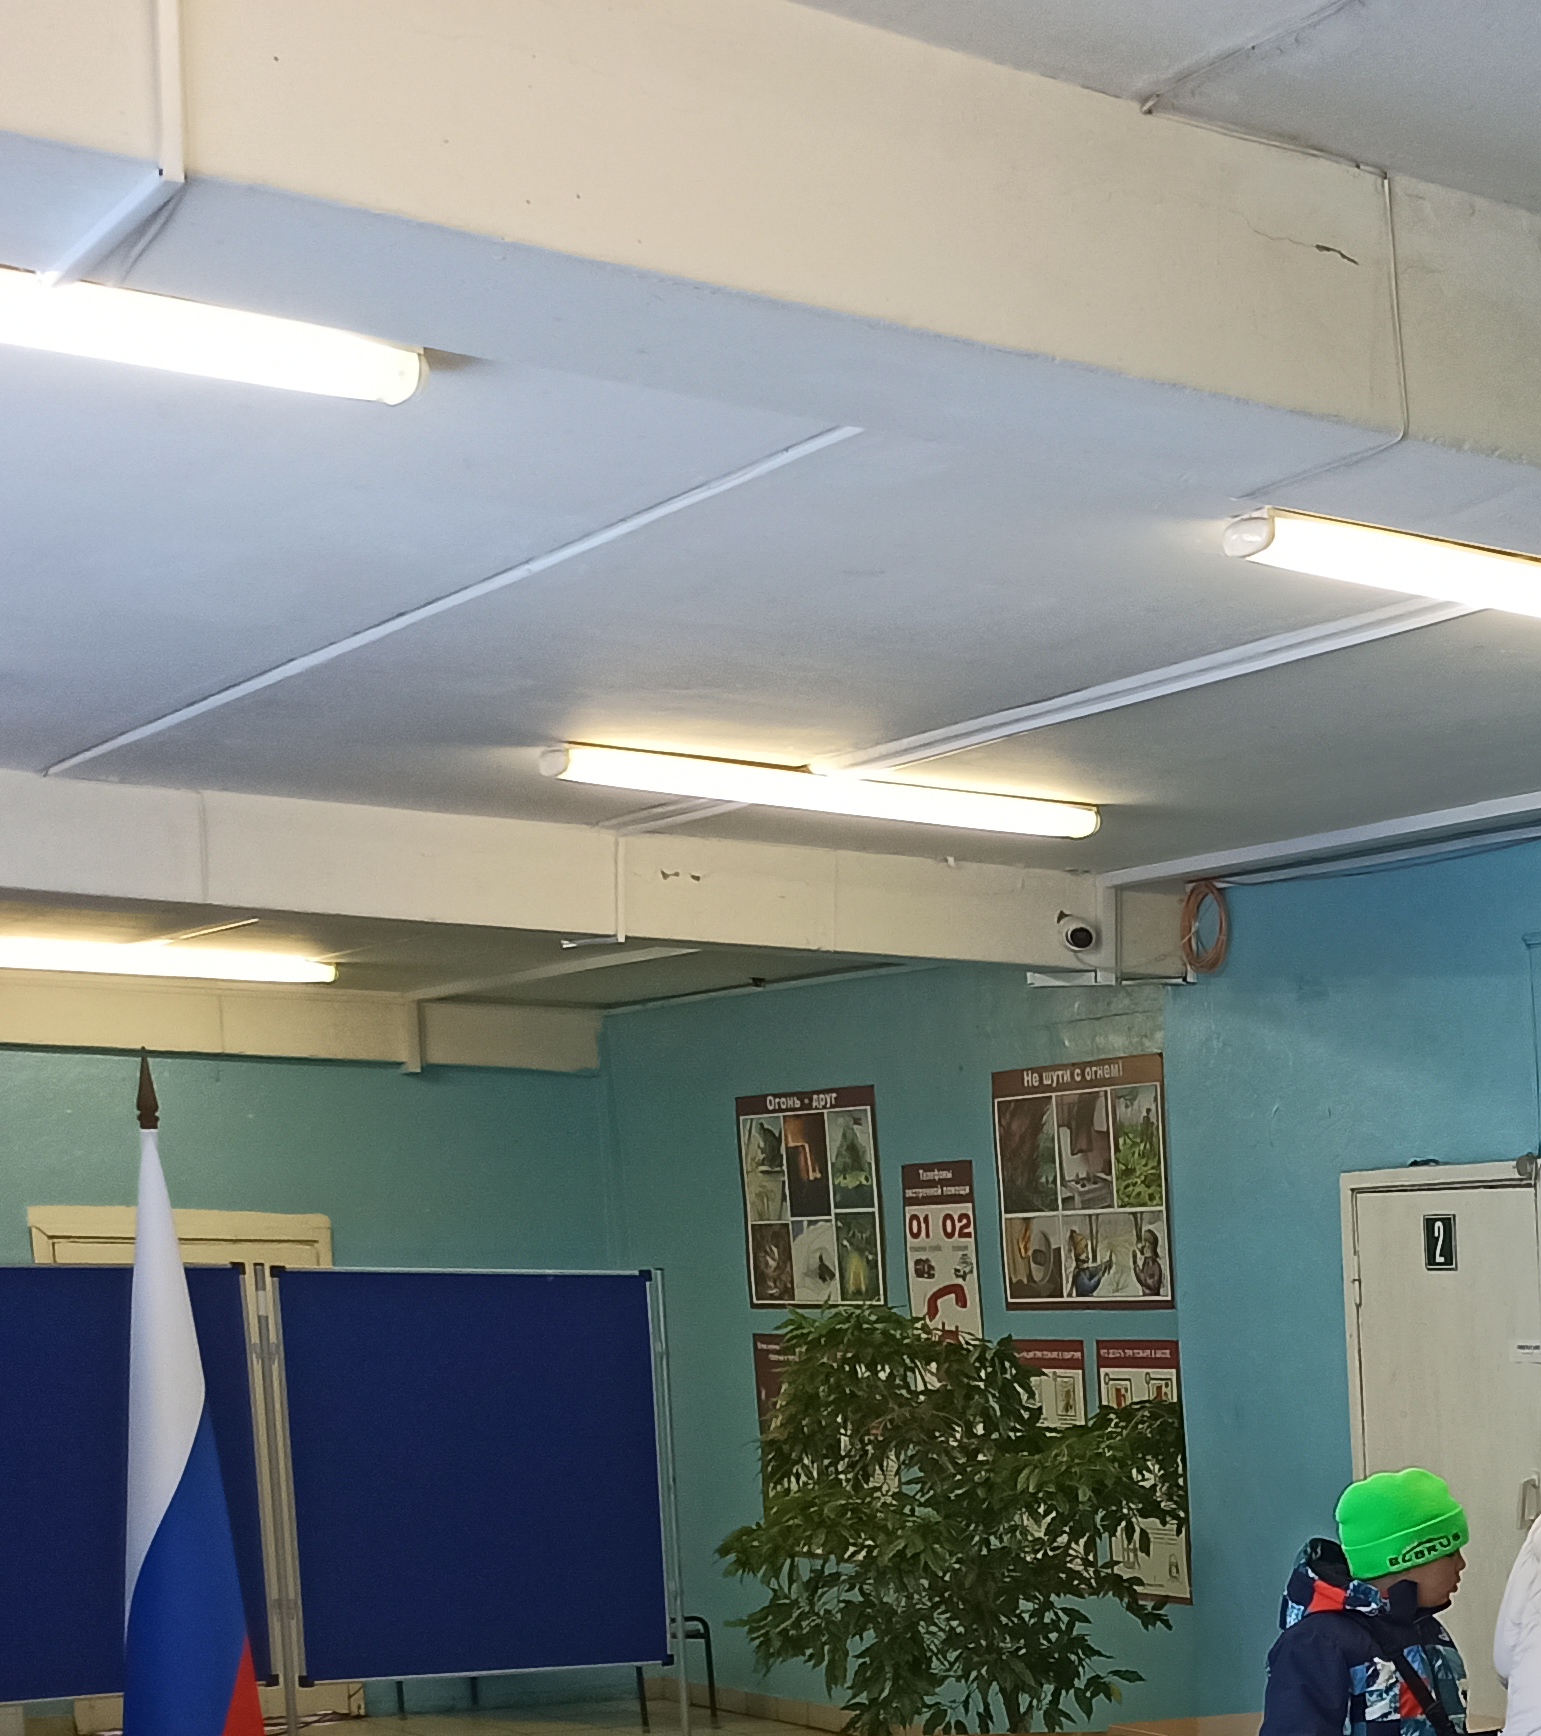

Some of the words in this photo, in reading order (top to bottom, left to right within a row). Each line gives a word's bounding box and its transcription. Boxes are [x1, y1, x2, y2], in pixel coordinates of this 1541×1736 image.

[1023, 1069, 1040, 1087] Не
[1042, 1067, 1071, 1084] шути
[1074, 1069, 1082, 1082] с
[766, 1094, 801, 1110] Огонь
[812, 1091, 838, 1109] друг
[908, 1213, 931, 1239] 01
[942, 1212, 973, 1239] 02
[1434, 1221, 1445, 1263] 2
